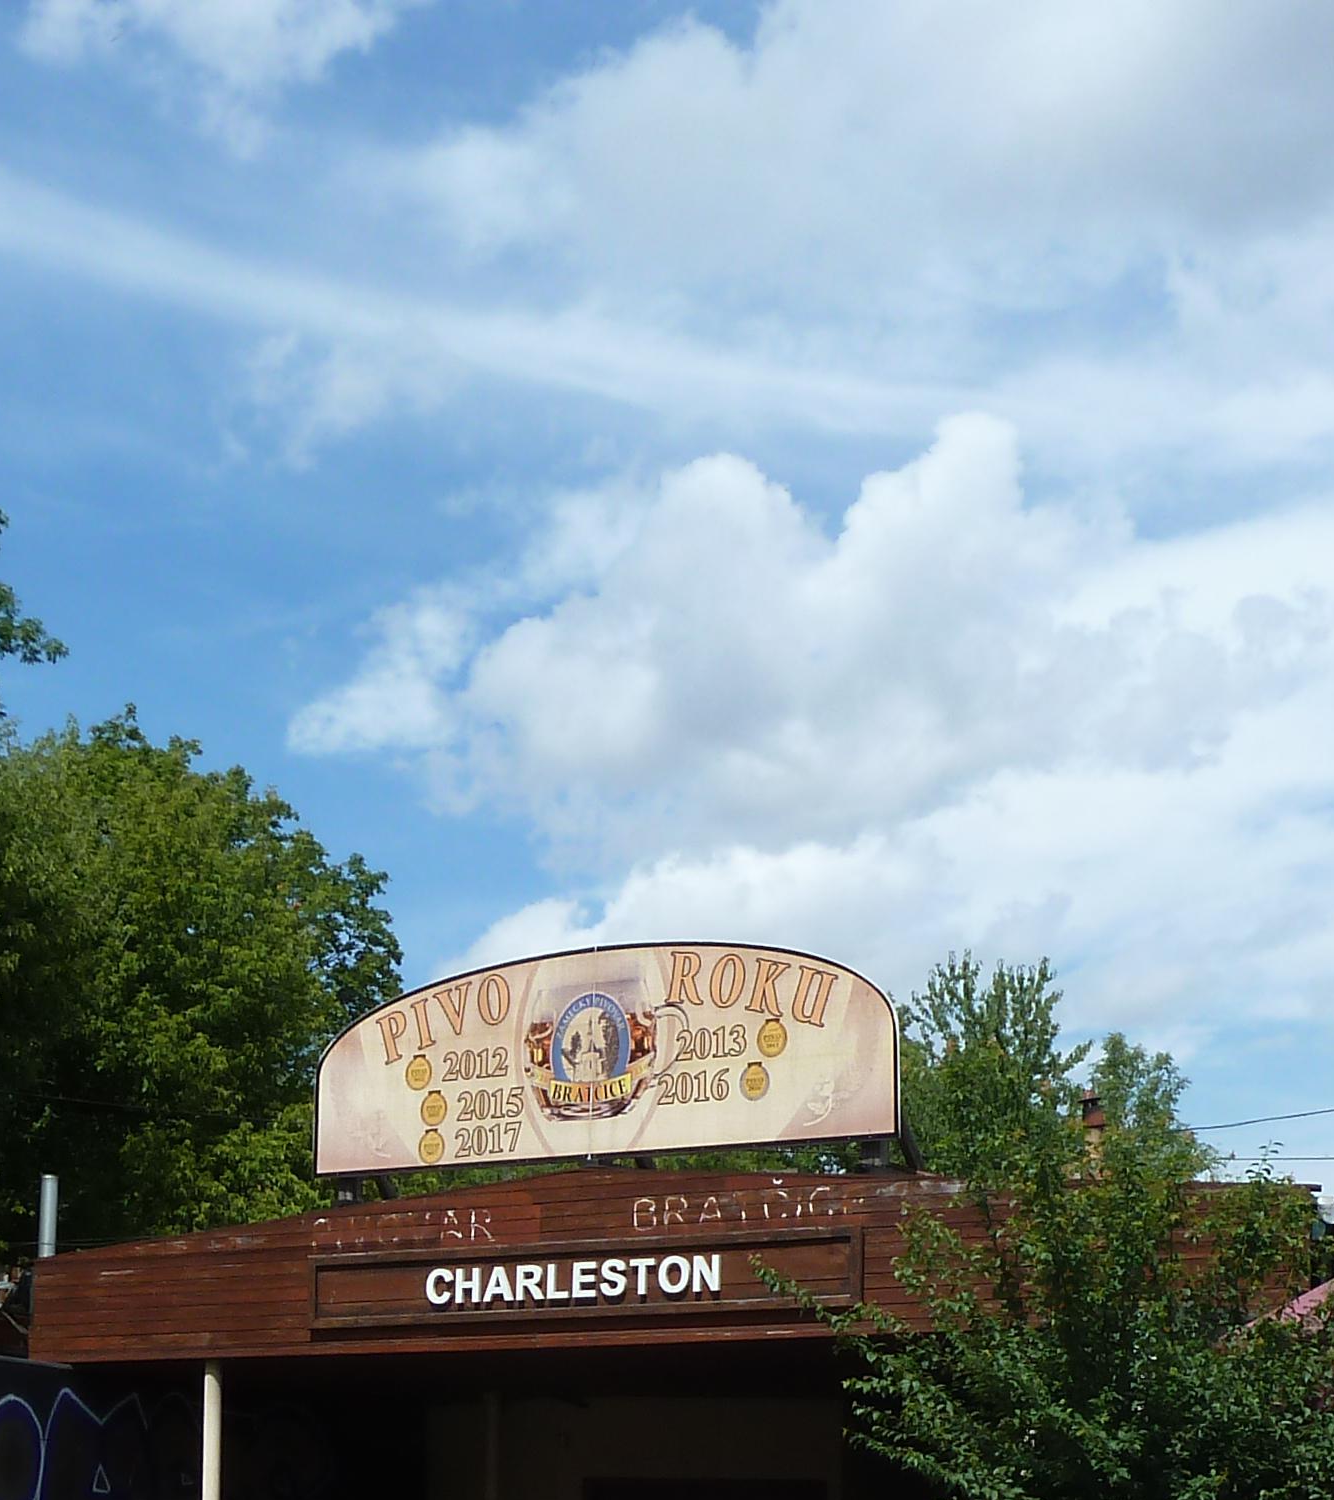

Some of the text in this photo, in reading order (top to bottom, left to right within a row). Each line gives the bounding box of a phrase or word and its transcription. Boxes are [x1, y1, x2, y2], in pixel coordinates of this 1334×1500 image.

[376, 951, 838, 1065] PIVO ROKU
[675, 1023, 746, 1061] 2013
[441, 1046, 508, 1081] 2012
[456, 1086, 524, 1121] 2015
[657, 1067, 730, 1105] 2016
[454, 1121, 522, 1158] 2017
[426, 1253, 722, 1305] CHARLESTON
